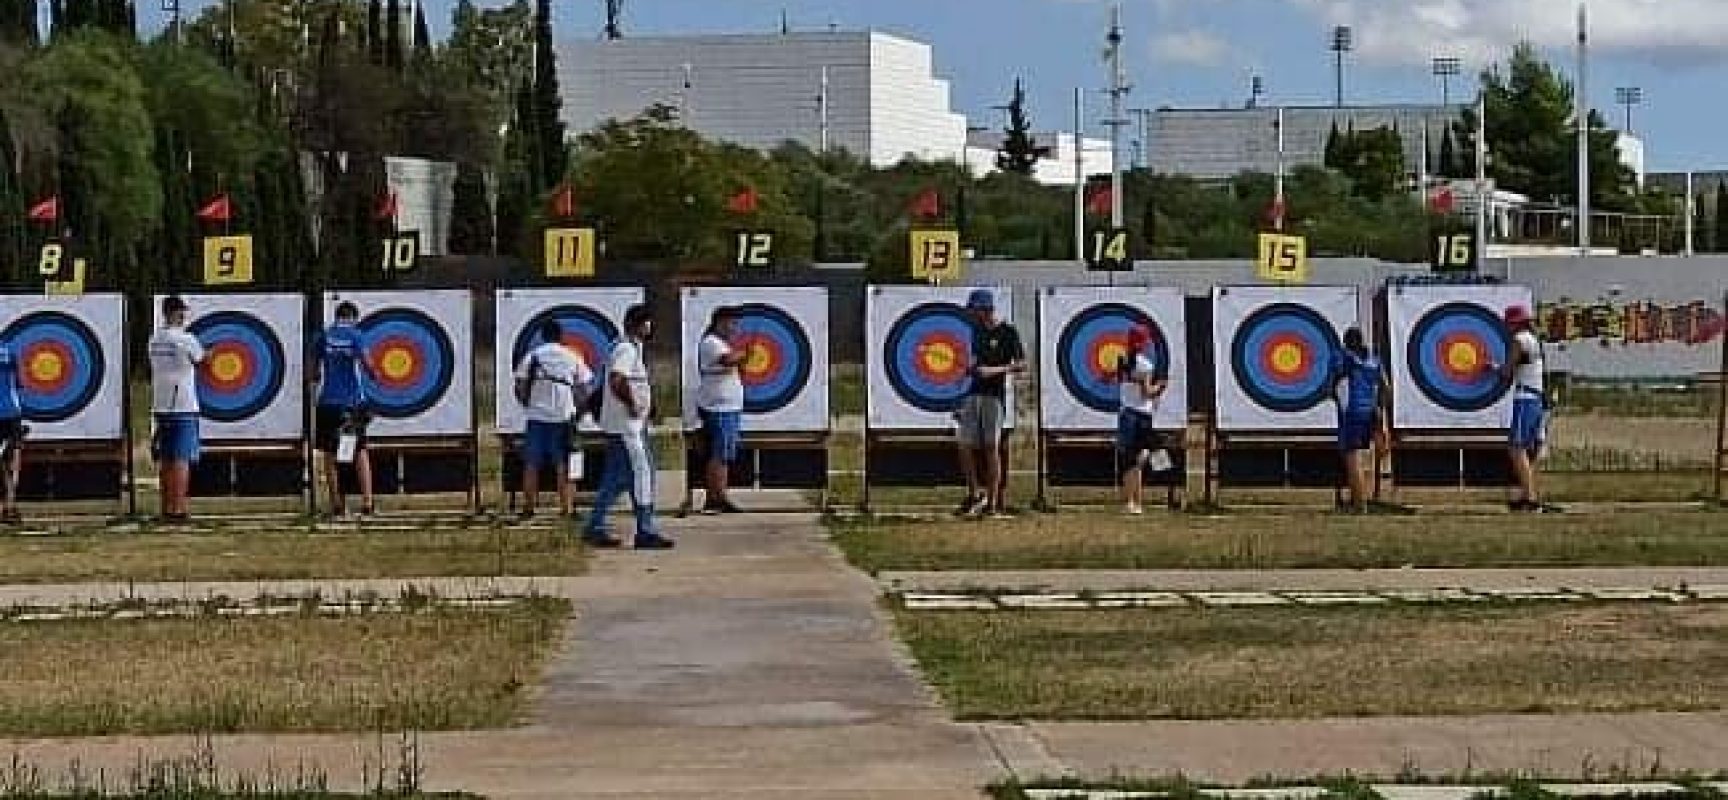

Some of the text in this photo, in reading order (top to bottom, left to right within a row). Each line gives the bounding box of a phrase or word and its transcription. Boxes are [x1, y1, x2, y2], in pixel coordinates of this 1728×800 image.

[40, 243, 62, 275] 8
[217, 246, 236, 276] 9
[382, 238, 415, 271] 10
[557, 235, 580, 267] 11
[737, 233, 771, 266] 12
[922, 240, 950, 271] 13
[1093, 232, 1127, 263] 14
[1268, 240, 1297, 271] 15
[1437, 235, 1471, 267] 16
